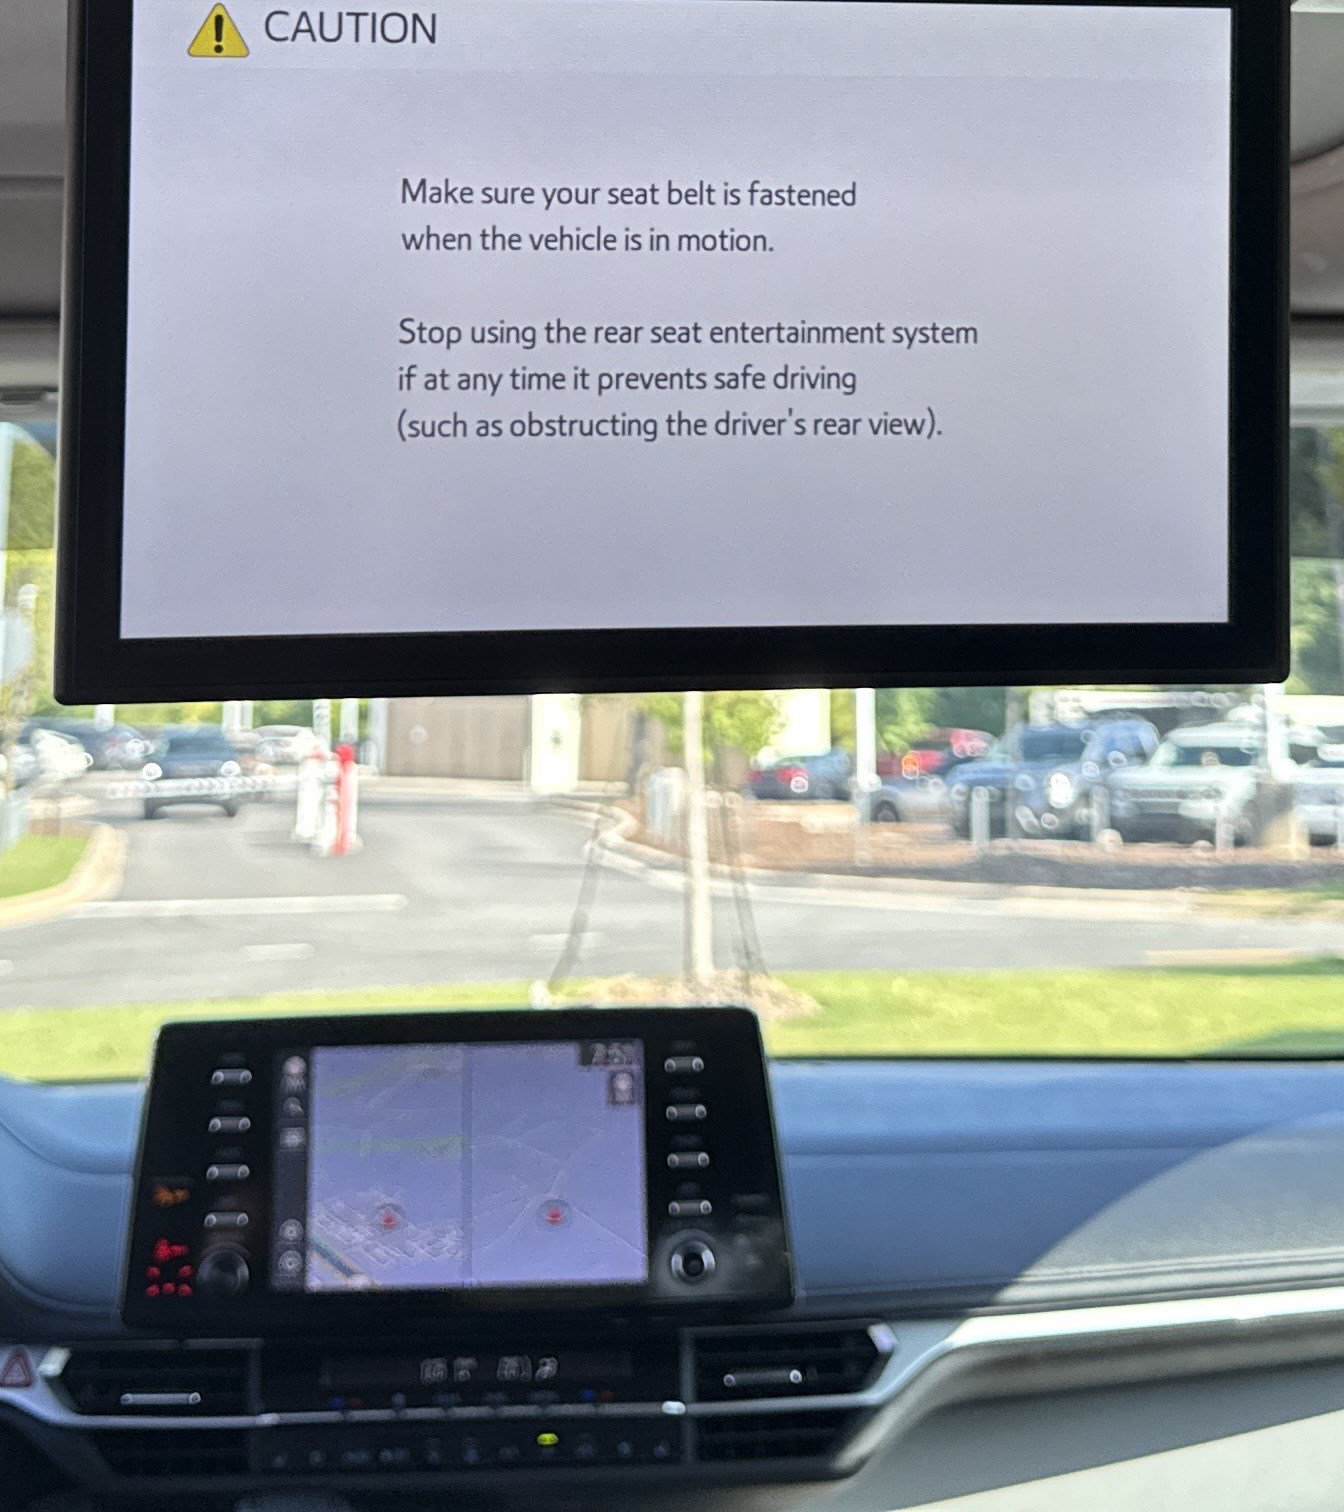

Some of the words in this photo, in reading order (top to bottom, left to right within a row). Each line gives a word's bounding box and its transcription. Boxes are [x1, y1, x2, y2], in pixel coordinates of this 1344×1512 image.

[264, 9, 437, 45] CAUTION
[401, 177, 474, 205] Make
[480, 186, 535, 205] sure
[541, 186, 602, 211] your
[607, 183, 660, 206] seat
[667, 179, 717, 206] belt
[723, 181, 741, 206] is
[747, 179, 857, 207] fastened
[400, 224, 472, 252] when
[479, 224, 523, 251] the
[528, 224, 618, 252] vehicle
[624, 226, 643, 252] is
[649, 227, 670, 252] in
[677, 227, 775, 253] motion.
[398, 317, 463, 351] Stop
[470, 319, 537, 351] using
[543, 317, 587, 345] the
[593, 325, 644, 345] rear
[649, 321, 703, 345] seat
[709, 319, 886, 345] entertainment
[891, 321, 978, 350] system
[398, 363, 418, 392] if
[423, 368, 450, 392] at
[456, 372, 504, 397] any
[509, 365, 567, 391] time
[573, 365, 591, 391] it
[597, 367, 708, 397] prevents
[713, 362, 767, 390] safe
[772, 363, 857, 397] driving
[397, 408, 468, 443] (such
[475, 419, 503, 438] as
[509, 410, 658, 443] obstructing
[665, 409, 708, 437] the
[714, 407, 807, 437] driver's
[813, 417, 863, 436] rear
[867, 405, 942, 440] view).
